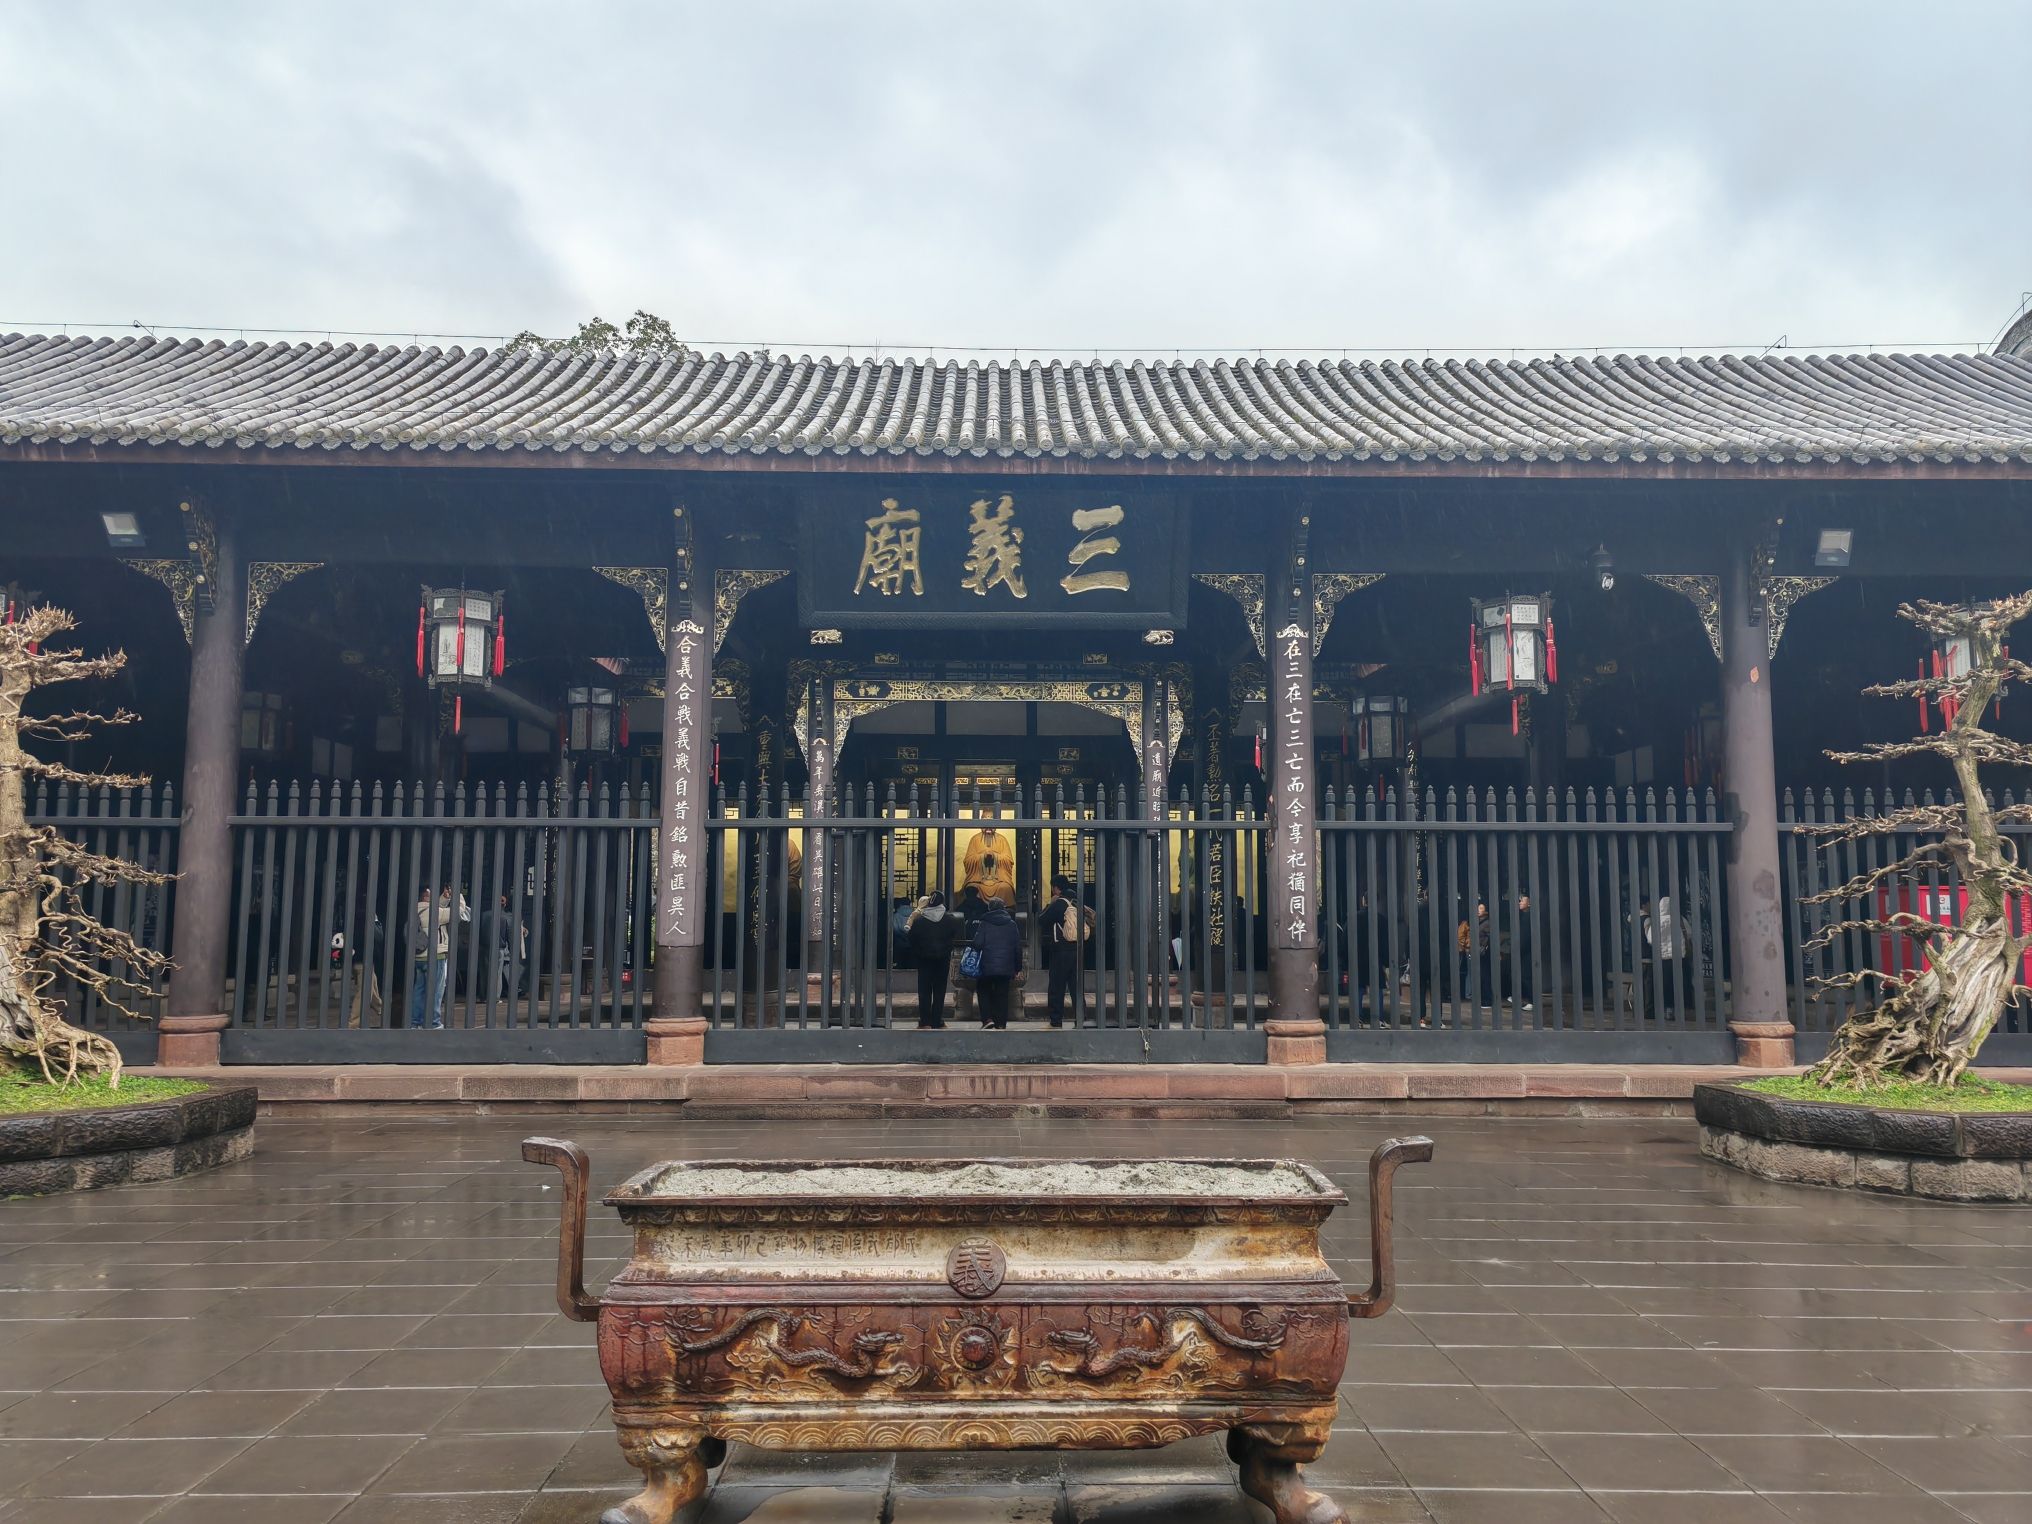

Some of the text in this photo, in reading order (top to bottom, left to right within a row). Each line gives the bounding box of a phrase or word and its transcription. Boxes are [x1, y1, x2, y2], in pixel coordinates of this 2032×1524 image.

[853, 494, 1131, 599] 三義廟
[954, 1239, 996, 1291] 義
